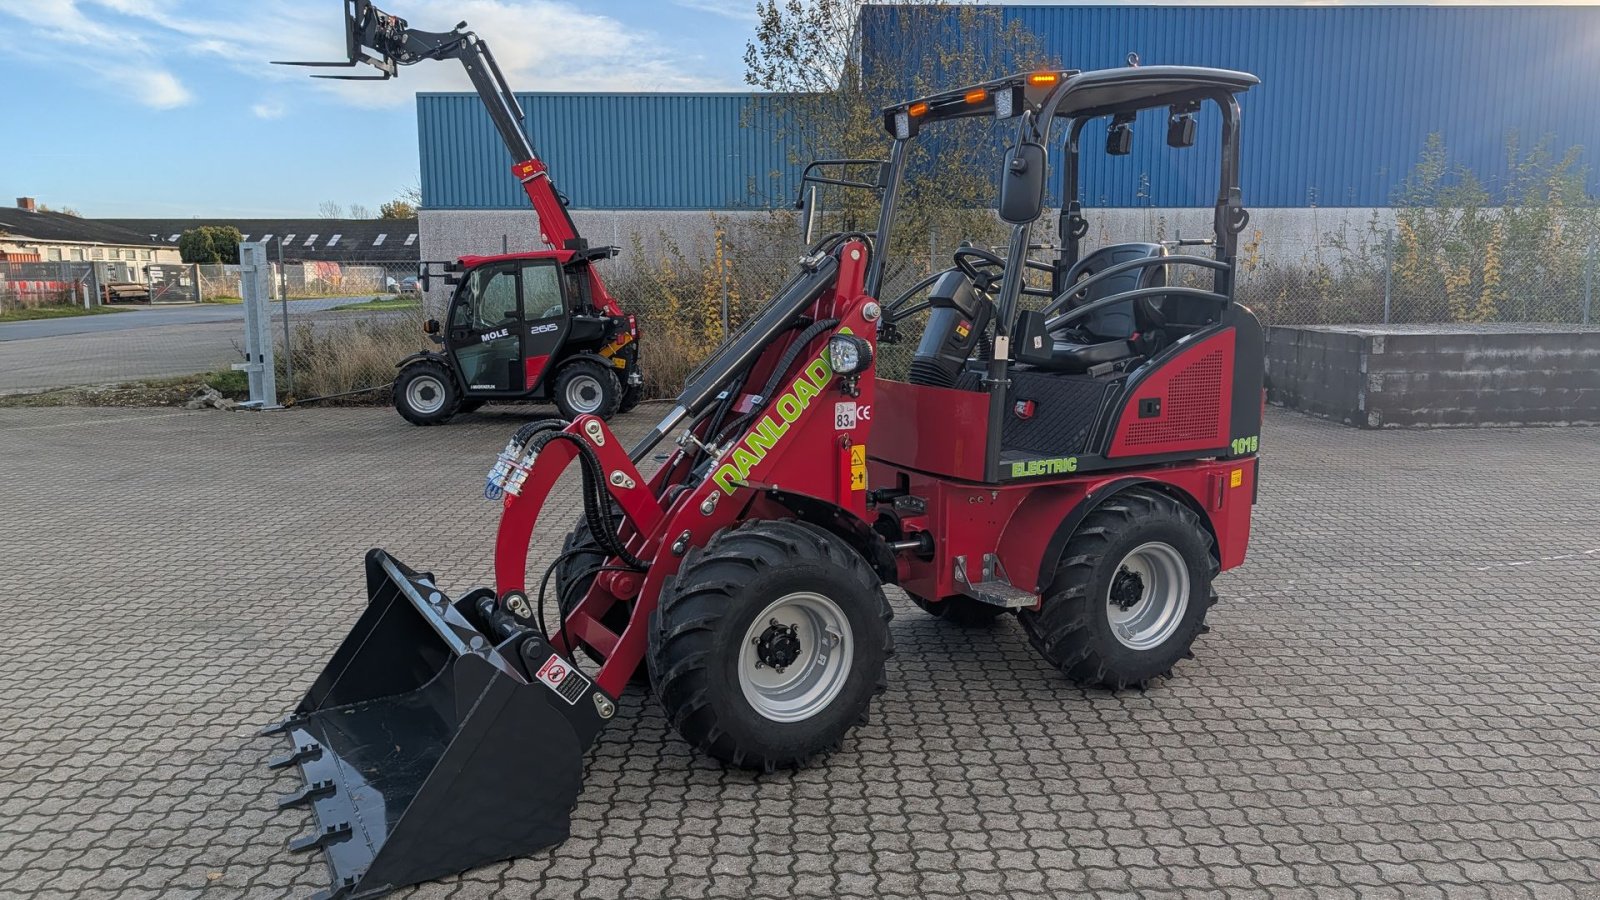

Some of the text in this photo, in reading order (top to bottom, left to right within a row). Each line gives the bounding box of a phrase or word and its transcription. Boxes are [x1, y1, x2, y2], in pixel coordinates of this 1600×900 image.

[481, 328, 509, 342] MOLE
[712, 327, 853, 496] DANLOAD
[857, 405, 871, 420] CE
[837, 414, 850, 427] 83
[1231, 435, 1258, 455] 1015
[1012, 457, 1077, 478] ELECTRIC
